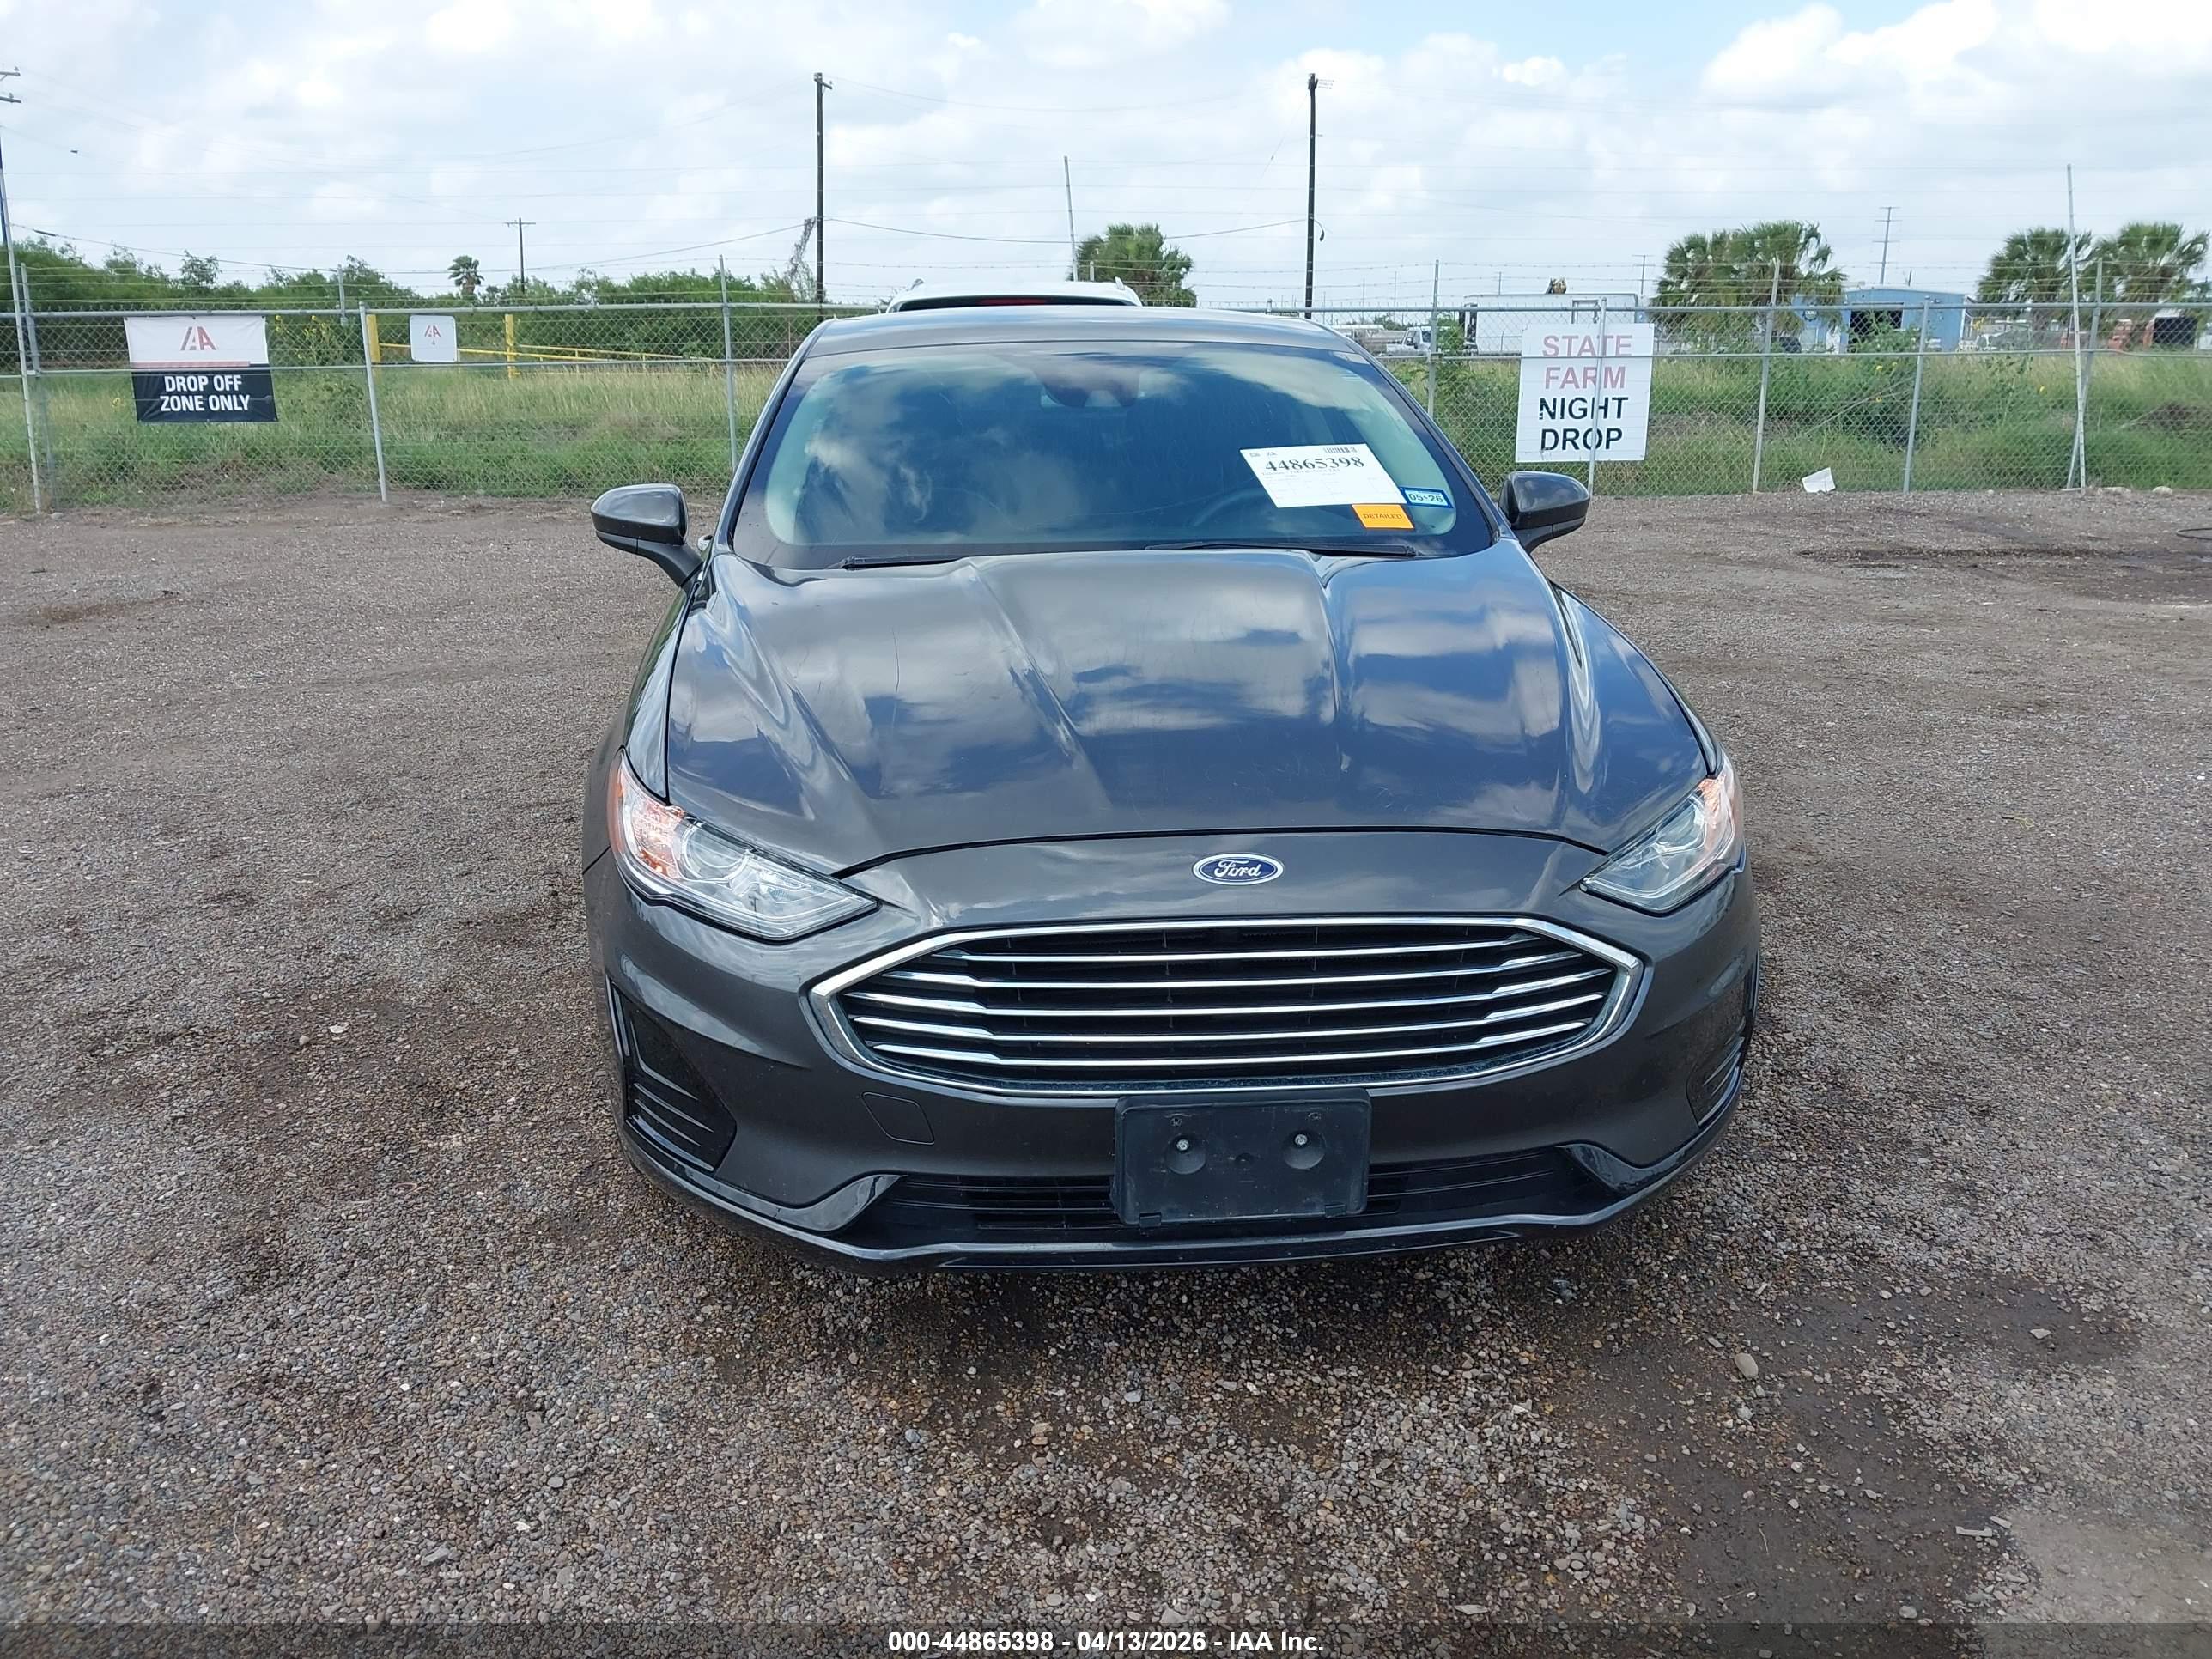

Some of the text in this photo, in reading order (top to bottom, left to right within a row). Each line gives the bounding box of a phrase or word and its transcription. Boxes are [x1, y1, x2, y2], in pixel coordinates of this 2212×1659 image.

[1542, 335, 1633, 357] STATE
[164, 374, 242, 392] DROP OFF
[1545, 366, 1626, 390] FARM
[160, 394, 250, 412] ZONE ONLY
[1539, 397, 1629, 420] NIGHT
[1540, 427, 1623, 451] DROP
[1265, 456, 1365, 471] 44865398
[1213, 860, 1262, 878] Ford
